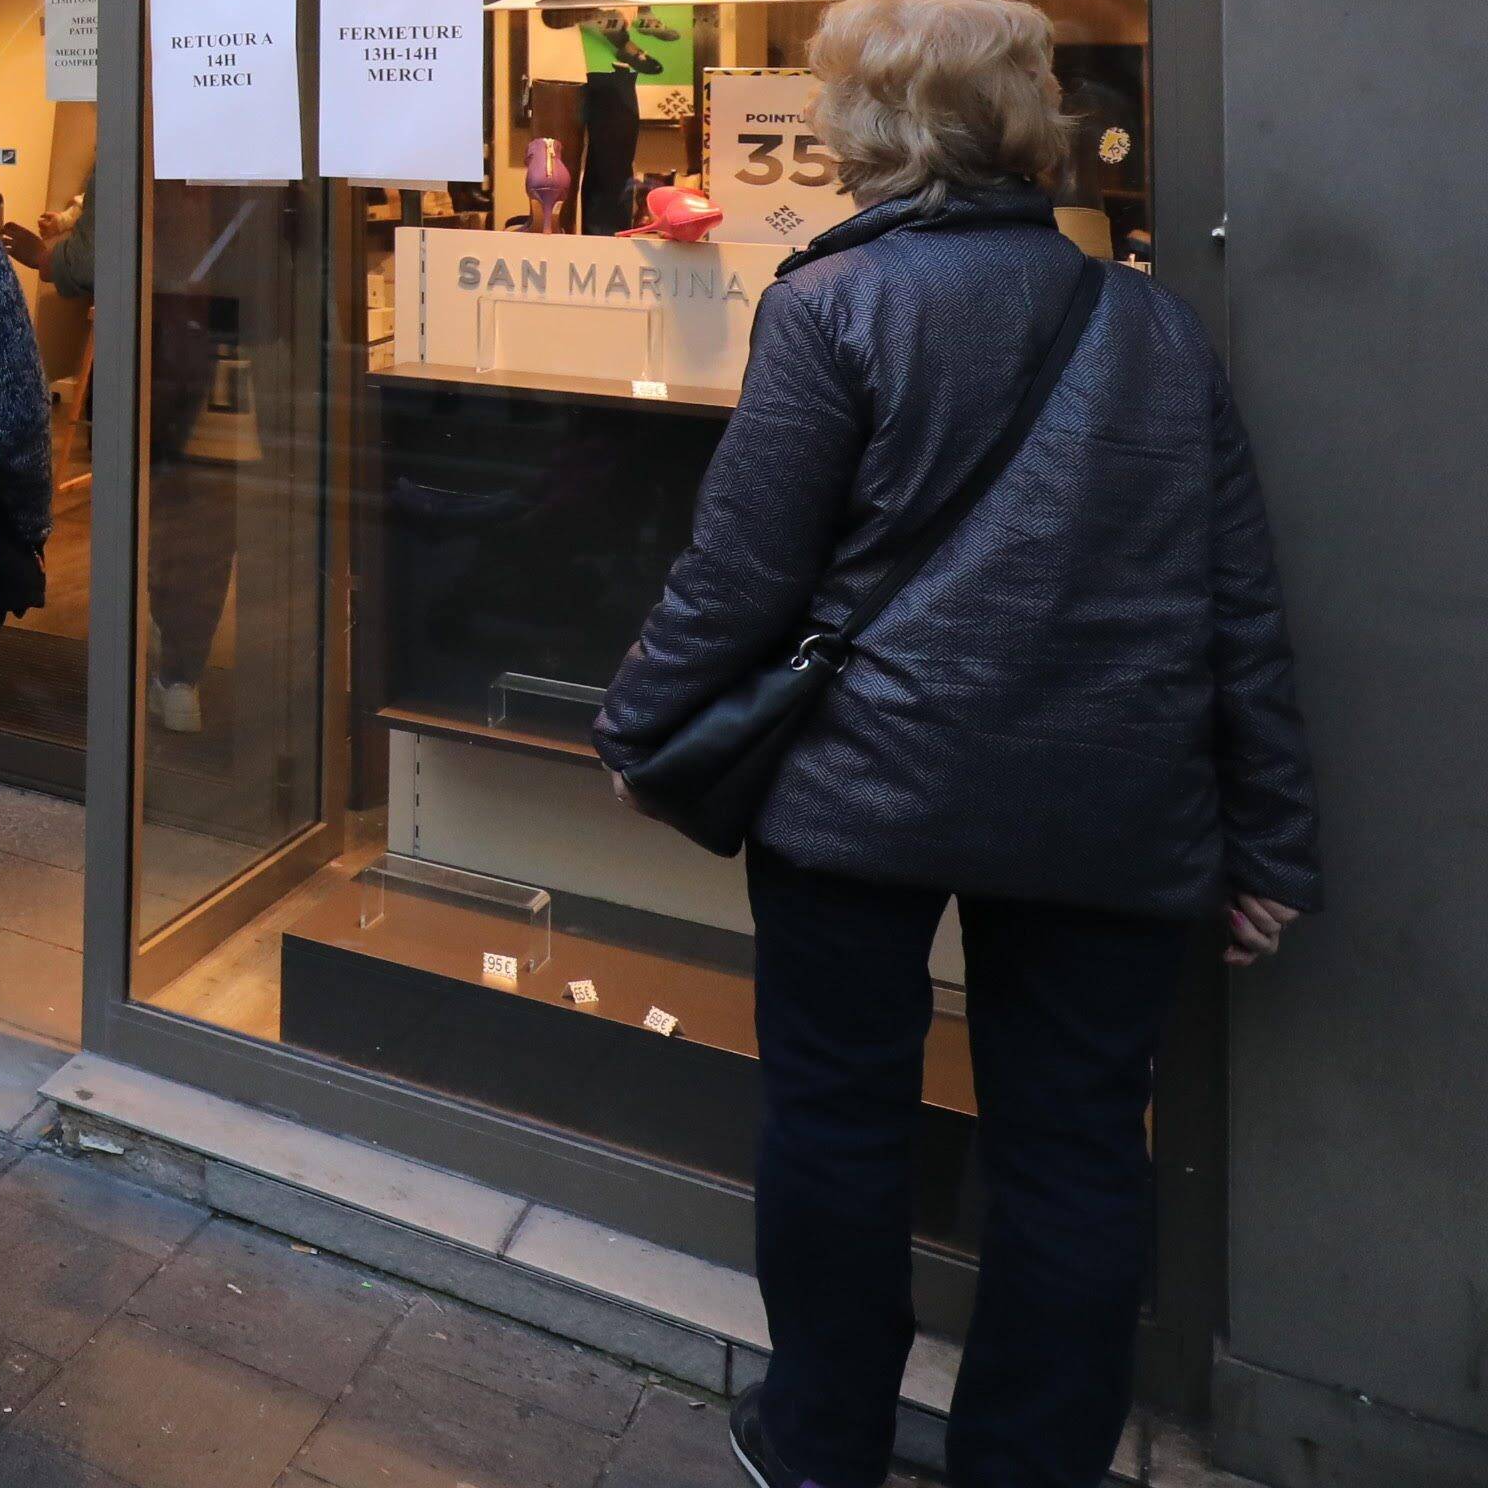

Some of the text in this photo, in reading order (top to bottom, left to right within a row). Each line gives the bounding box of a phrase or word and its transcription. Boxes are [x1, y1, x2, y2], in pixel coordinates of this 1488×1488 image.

[172, 32, 274, 49] RETUOUR A
[338, 25, 463, 41] FERMETURE
[55, 48, 87, 56] MERCI
[206, 53, 237, 67] 14H
[362, 46, 438, 61] 13H-14H
[192, 73, 253, 88] MERCI
[367, 68, 434, 83] MERCI
[734, 134, 836, 187] 35
[765, 204, 791, 224] SAN
[773, 209, 798, 231] MAR
[781, 217, 805, 235] INA
[458, 256, 750, 305] SAN MARINA
